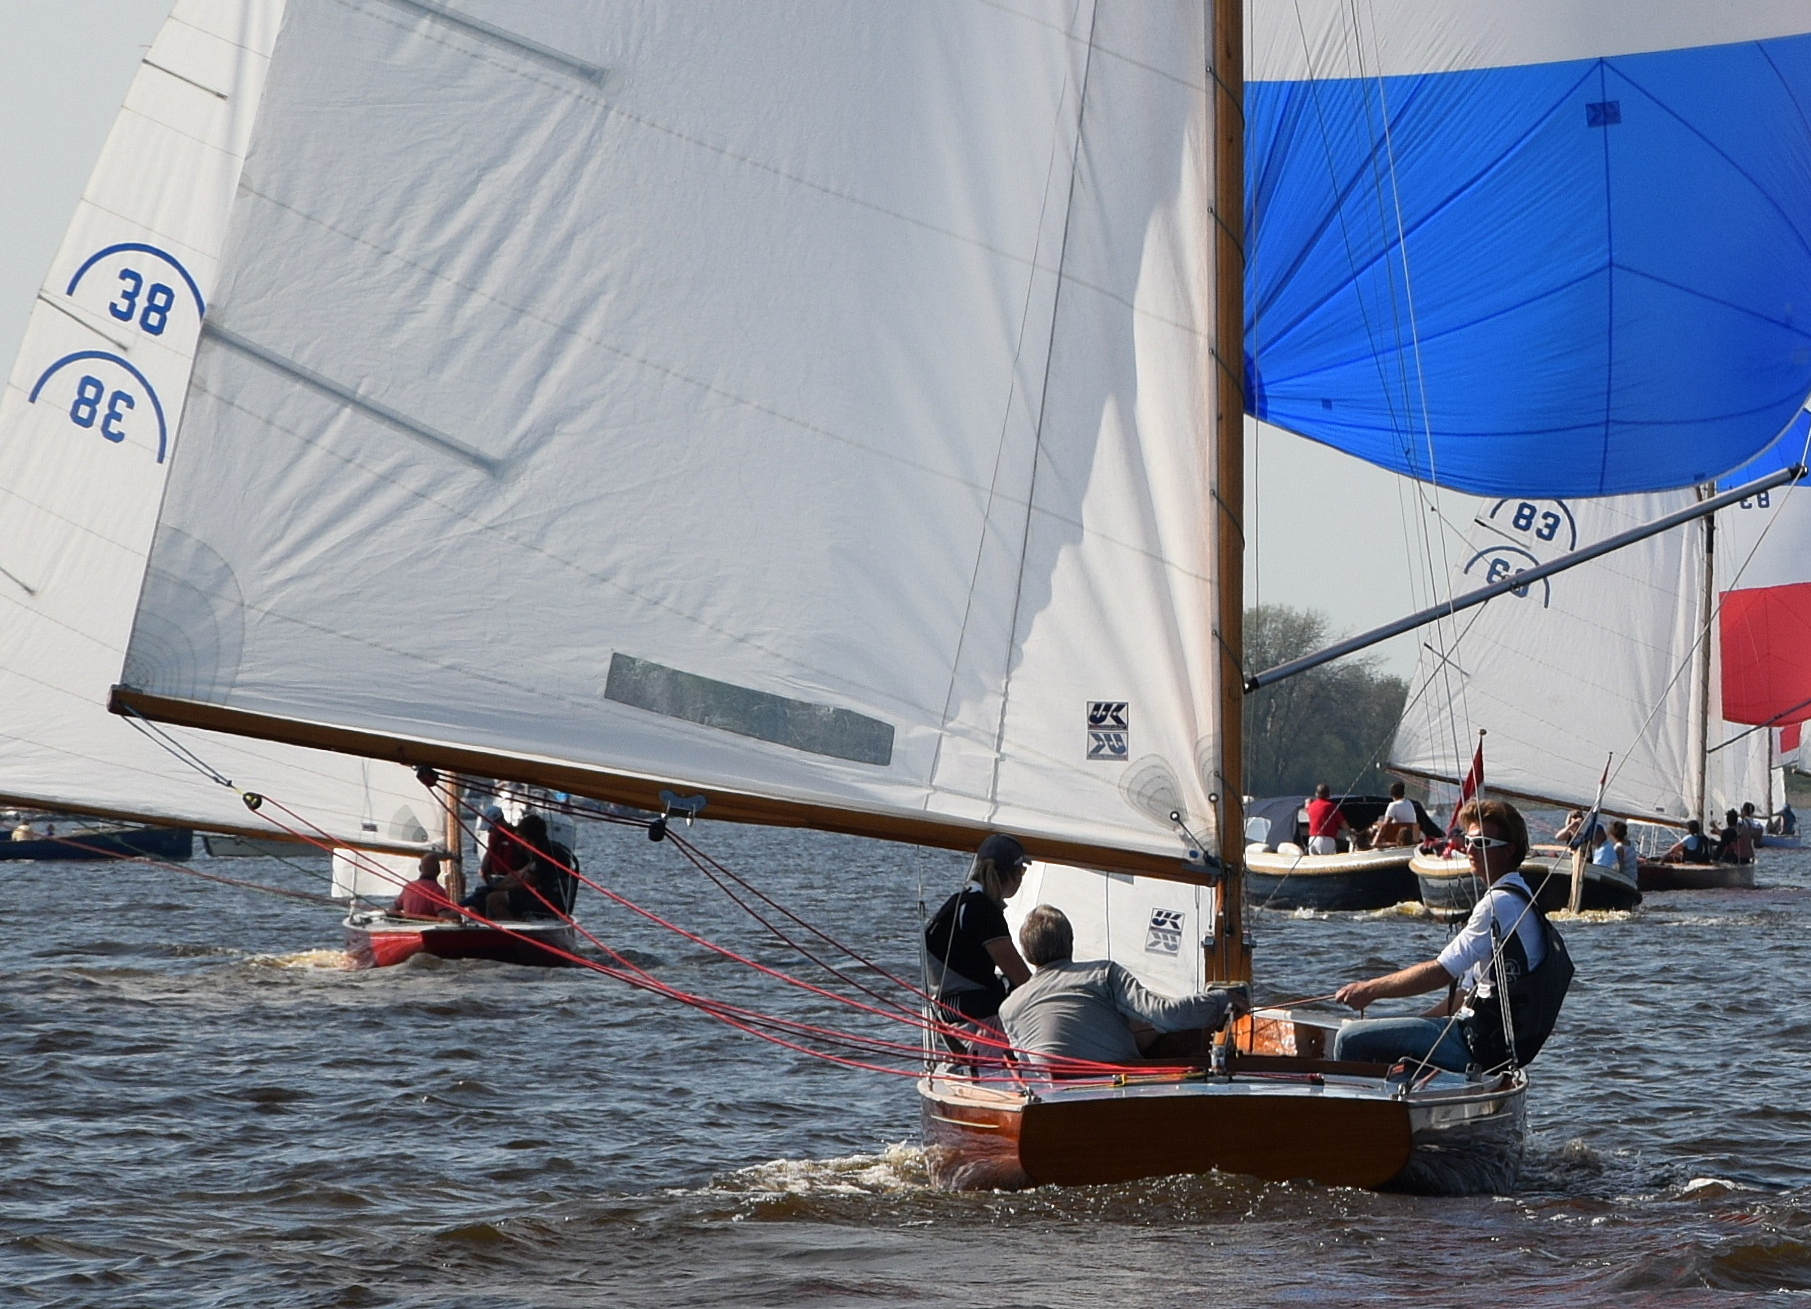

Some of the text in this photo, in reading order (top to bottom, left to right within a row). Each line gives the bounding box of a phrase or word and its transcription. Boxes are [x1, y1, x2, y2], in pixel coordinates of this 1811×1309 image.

[109, 268, 175, 336] 38
[1512, 502, 1561, 541] 83
[1089, 703, 1126, 727] UK
[1152, 910, 1182, 930] UK
